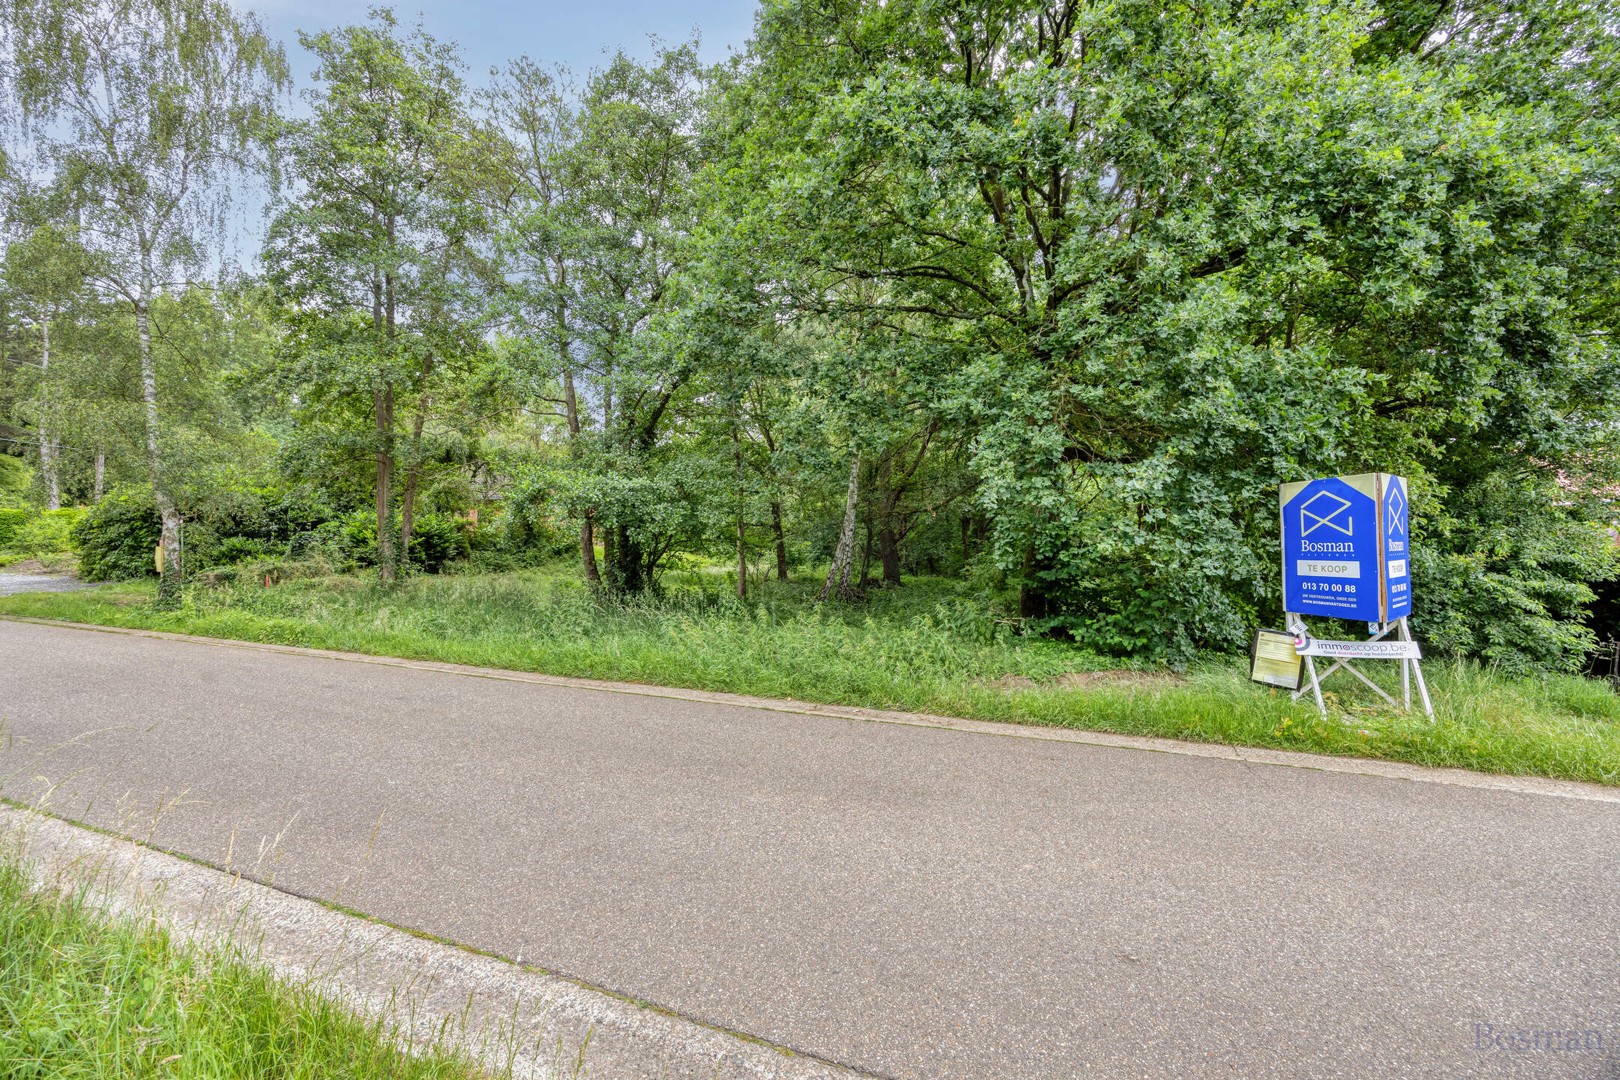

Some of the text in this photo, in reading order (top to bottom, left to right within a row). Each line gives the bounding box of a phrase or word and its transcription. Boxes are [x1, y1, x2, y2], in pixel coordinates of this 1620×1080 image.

[1301, 539, 1354, 552] Bosman
[1307, 564, 1348, 574] TE KOOP
[1302, 582, 1356, 593] 013 70 00 88
[1317, 641, 1407, 652] immoscoop.be
